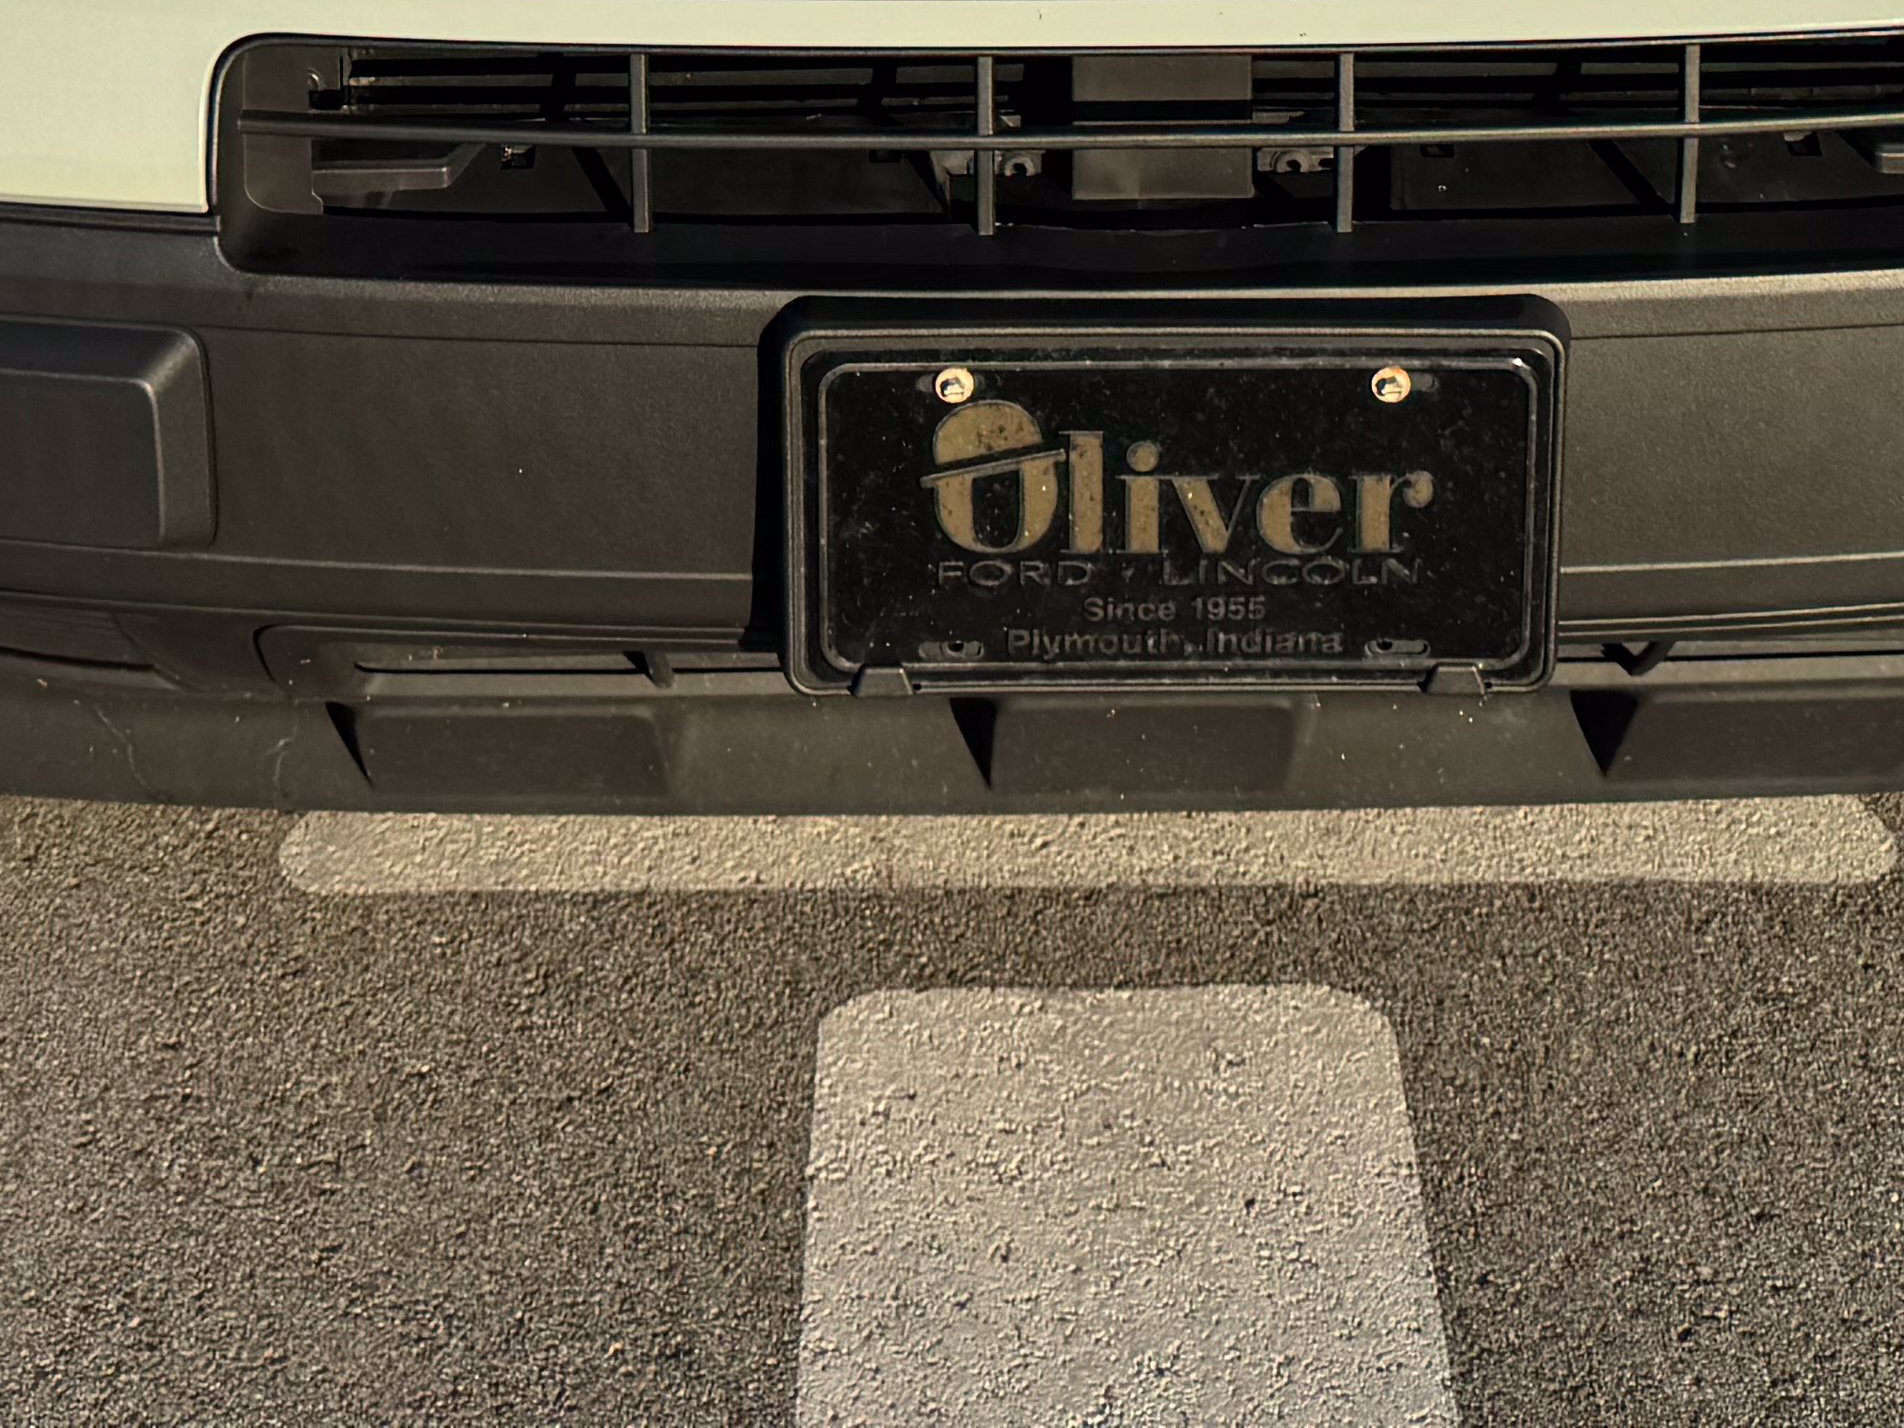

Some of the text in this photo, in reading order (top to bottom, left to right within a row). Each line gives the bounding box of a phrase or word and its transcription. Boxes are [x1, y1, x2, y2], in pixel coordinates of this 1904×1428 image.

[920, 400, 1436, 554] Oliver
[937, 558, 1424, 587] FORD LINCOLN
[1083, 596, 1267, 622] Since 1955
[1207, 627, 1344, 654] Indiana
